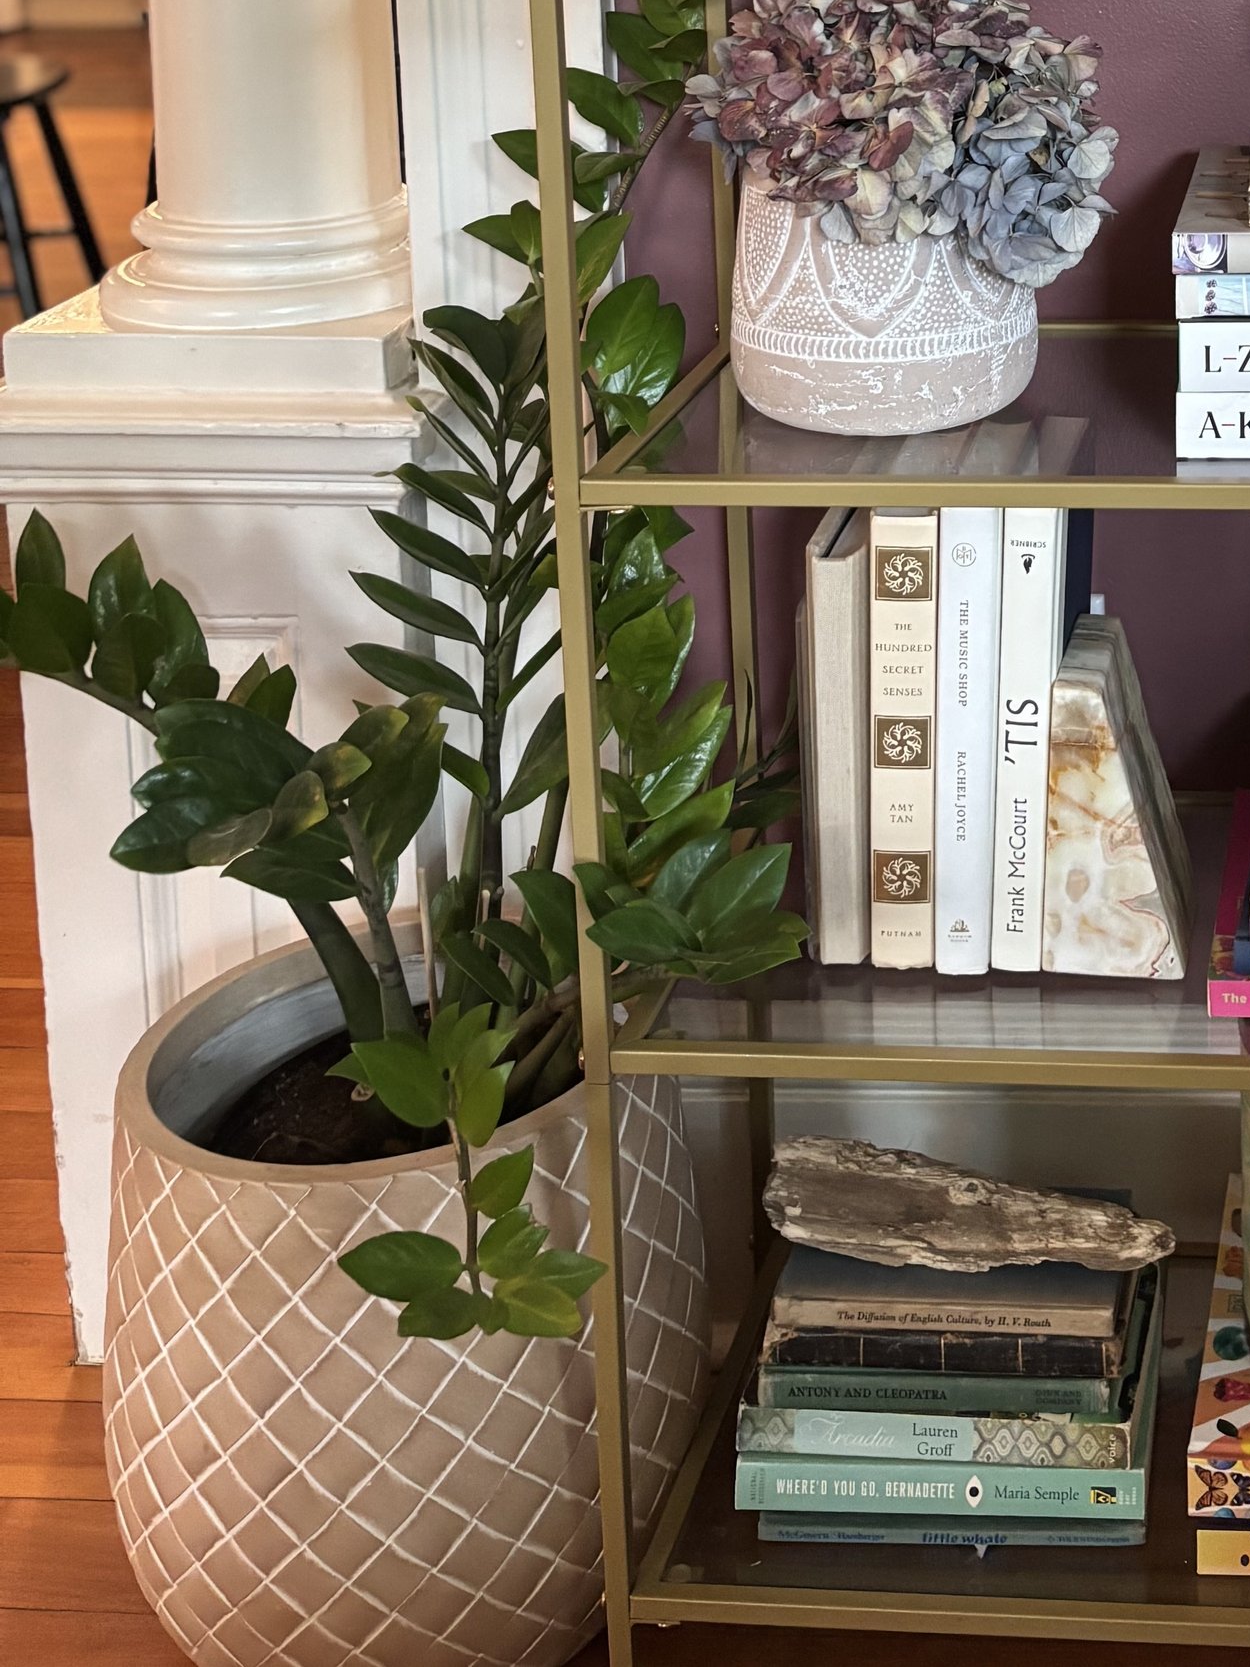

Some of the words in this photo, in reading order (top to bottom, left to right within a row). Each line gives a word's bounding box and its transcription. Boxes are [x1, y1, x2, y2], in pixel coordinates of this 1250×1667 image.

[1009, 538, 1048, 549] SCRIBNER
[959, 599, 970, 626] THE
[893, 623, 913, 631] THE
[875, 642, 933, 653] HUNDRED
[958, 629, 969, 670] MUSIC
[882, 665, 924, 675] SECRET
[882, 687, 923, 697] SENSES
[957, 671, 969, 707] SHOP
[956, 750, 967, 802] RACHEL
[889, 803, 914, 812] AMY
[889, 814, 914, 823] TAN
[954, 803, 967, 842] JOYCE
[1007, 797, 1028, 879] McCourt
[1006, 886, 1026, 934] Frank
[1222, 992, 1248, 1004] The
[837, 1310, 855, 1321] The
[856, 1311, 896, 1322] Diffusion
[898, 1313, 909, 1324] of
[910, 1313, 944, 1325] English
[984, 1315, 995, 1327] by
[1011, 1317, 1021, 1327] V.
[787, 1386, 842, 1399] ANTONY
[845, 1387, 872, 1399] AND
[875, 1387, 948, 1401] CLEOPATRA
[911, 1421, 959, 1439] Lauren
[916, 1441, 956, 1458] Groff
[1108, 1434, 1118, 1464] voice
[775, 1478, 828, 1496] WHERE'D
[833, 1479, 856, 1497] YOU
[885, 1481, 956, 1500] BERNADETTE
[993, 1485, 1030, 1500] Maria
[1034, 1486, 1080, 1505] Semple
